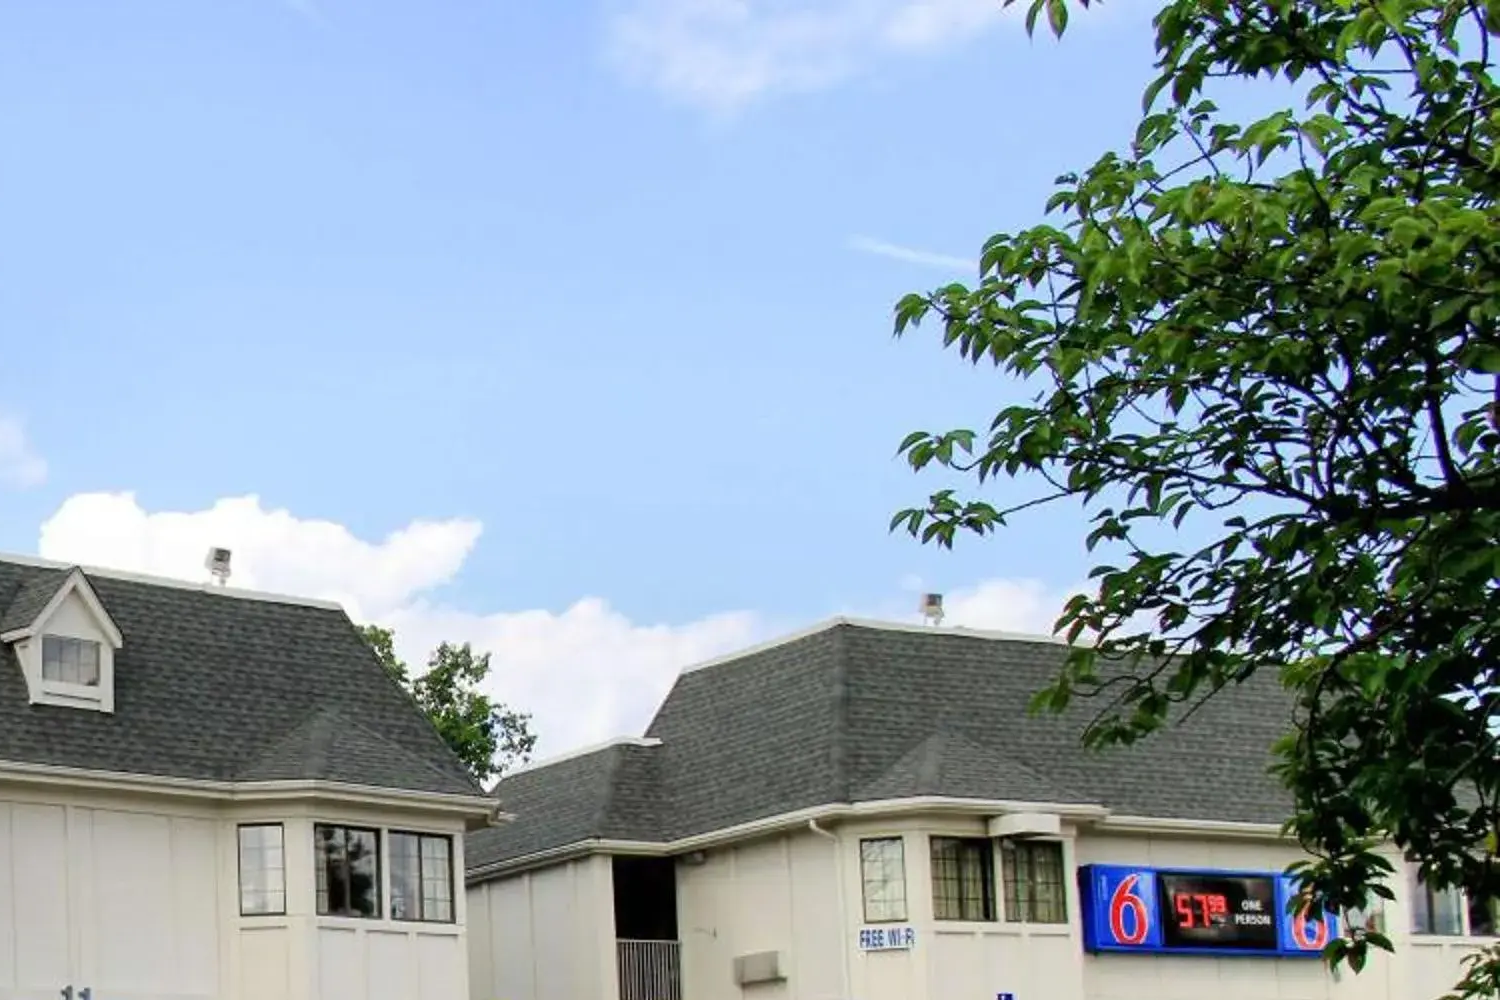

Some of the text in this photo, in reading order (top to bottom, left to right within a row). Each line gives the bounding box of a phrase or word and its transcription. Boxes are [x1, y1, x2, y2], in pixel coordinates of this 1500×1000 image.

[1109, 873, 1148, 945] 6
[1241, 898, 1264, 911] ONE
[1235, 913, 1271, 925] PERSON
[859, 929, 884, 948] FREE
